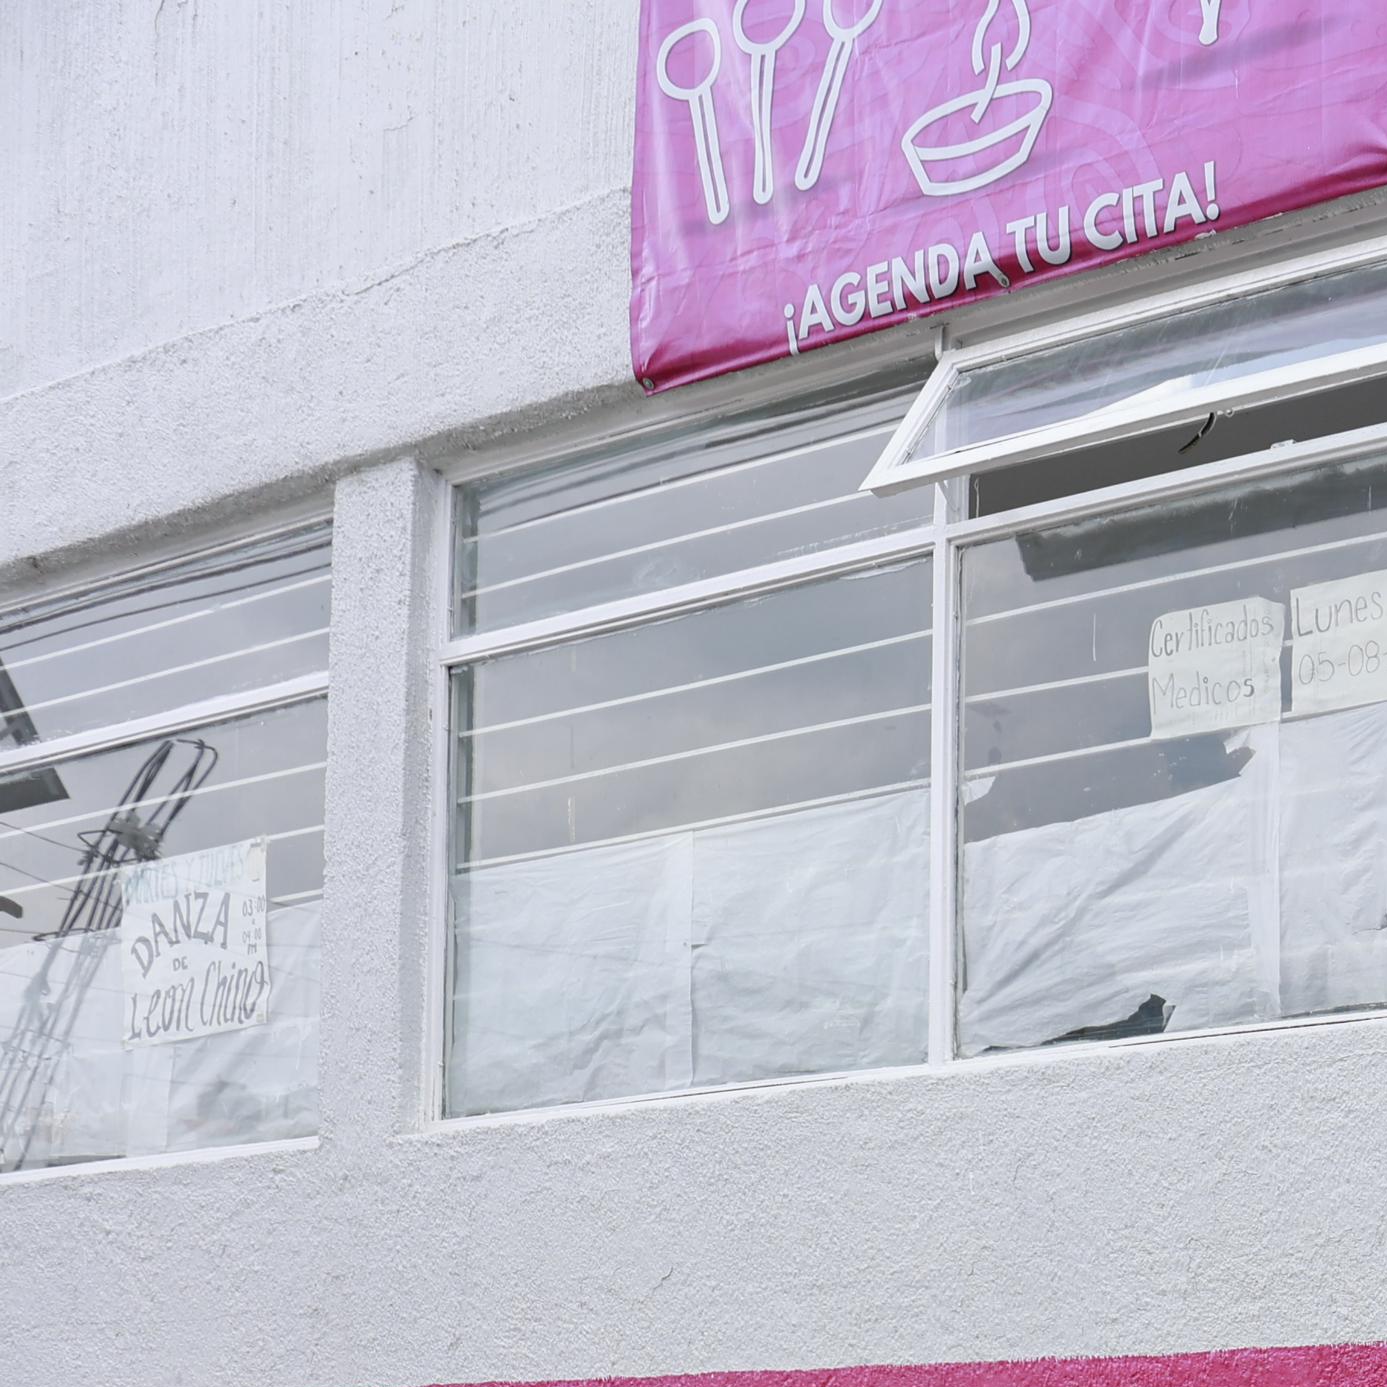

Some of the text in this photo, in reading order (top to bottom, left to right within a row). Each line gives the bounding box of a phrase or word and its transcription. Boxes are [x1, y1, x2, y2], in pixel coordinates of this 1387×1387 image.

[784, 161, 1220, 355] ¡AGENDA TU CITA!
[1151, 604, 1275, 658] Certificados
[1296, 591, 1384, 637] Lunes
[1151, 671, 1256, 715] Medicos
[131, 891, 231, 978] DANZA
[173, 956, 188, 972] DE
[128, 960, 269, 1041] Leon Chino
